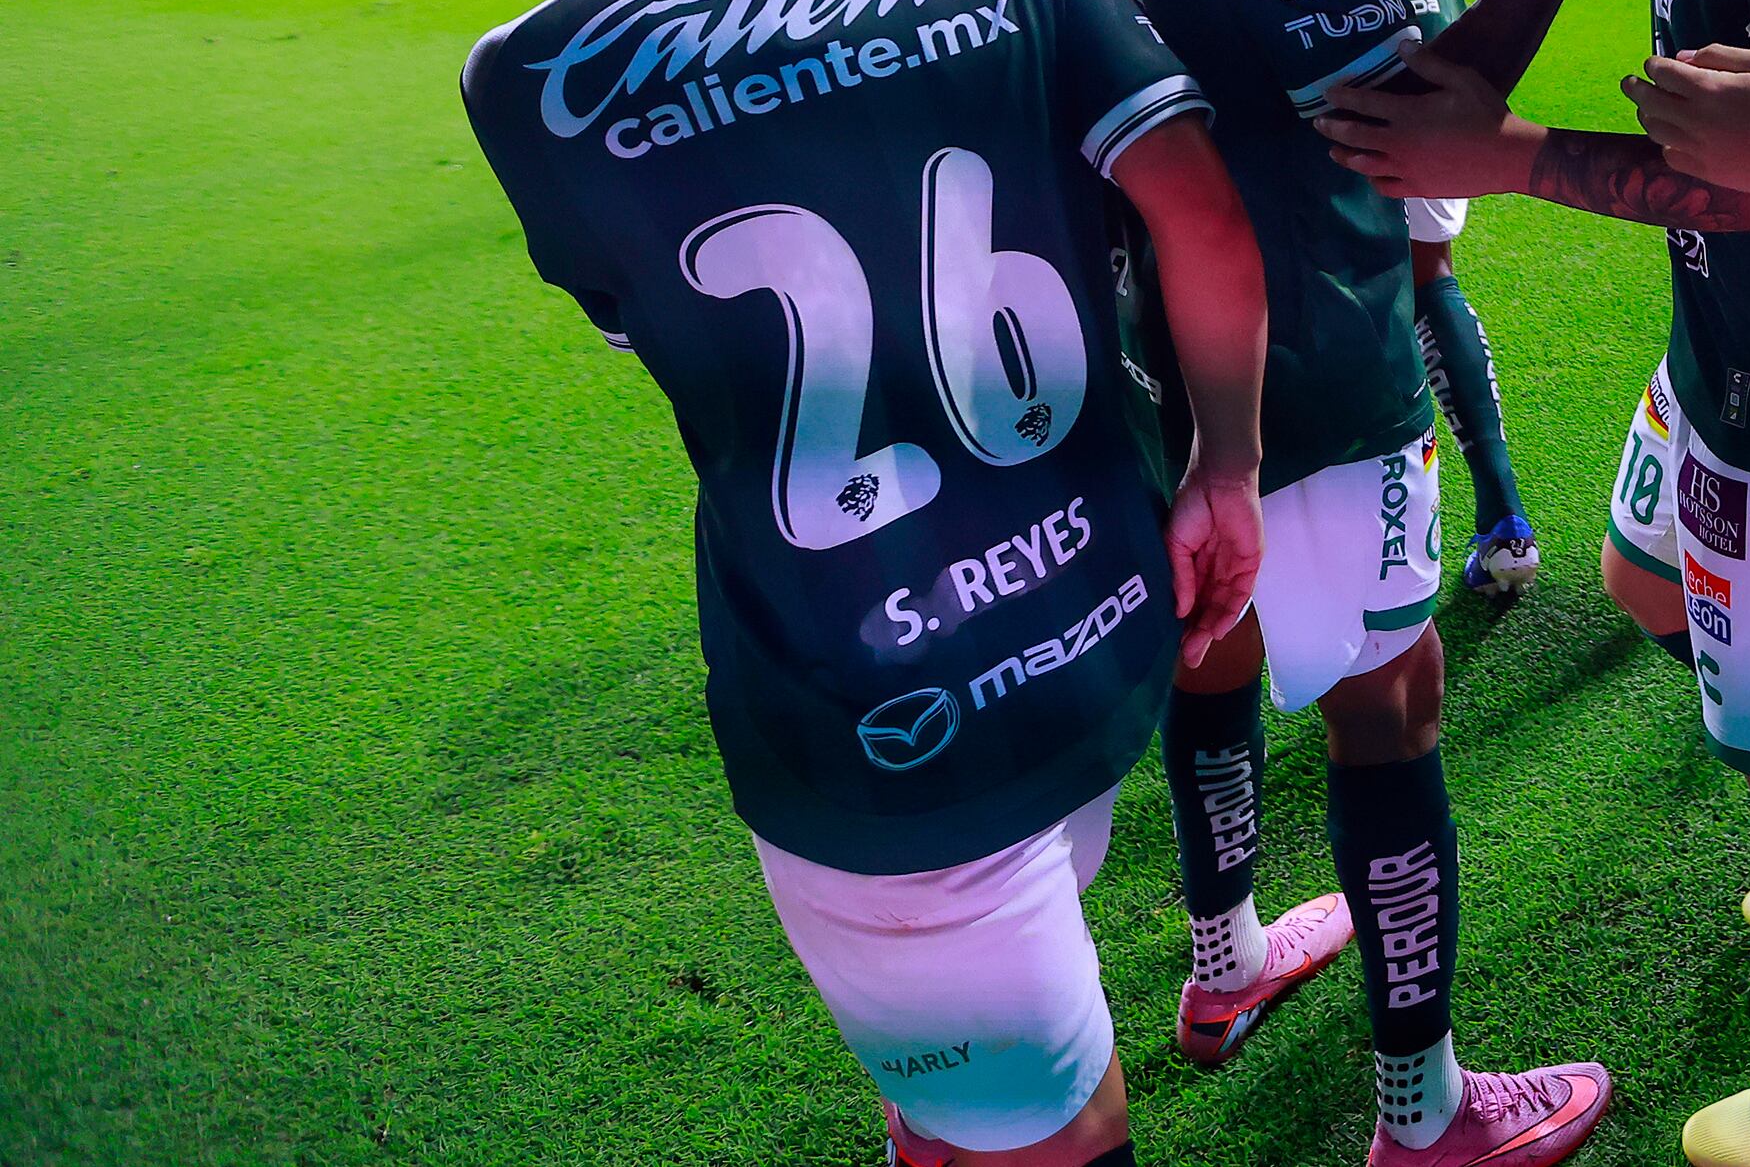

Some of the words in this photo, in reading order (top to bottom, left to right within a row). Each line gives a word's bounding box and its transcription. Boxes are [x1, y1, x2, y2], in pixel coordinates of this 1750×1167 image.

[679, 146, 1088, 551] 26
[1379, 454, 1409, 582] ROXEL
[1619, 429, 1664, 526] 10
[1679, 488, 1740, 540] HOTSSON
[1689, 464, 1721, 514] HS
[883, 586, 940, 647] S.
[949, 496, 1092, 612] REYES
[1685, 552, 1728, 604] leche
[1699, 524, 1738, 554] HOTEL
[968, 574, 1149, 711] mazda
